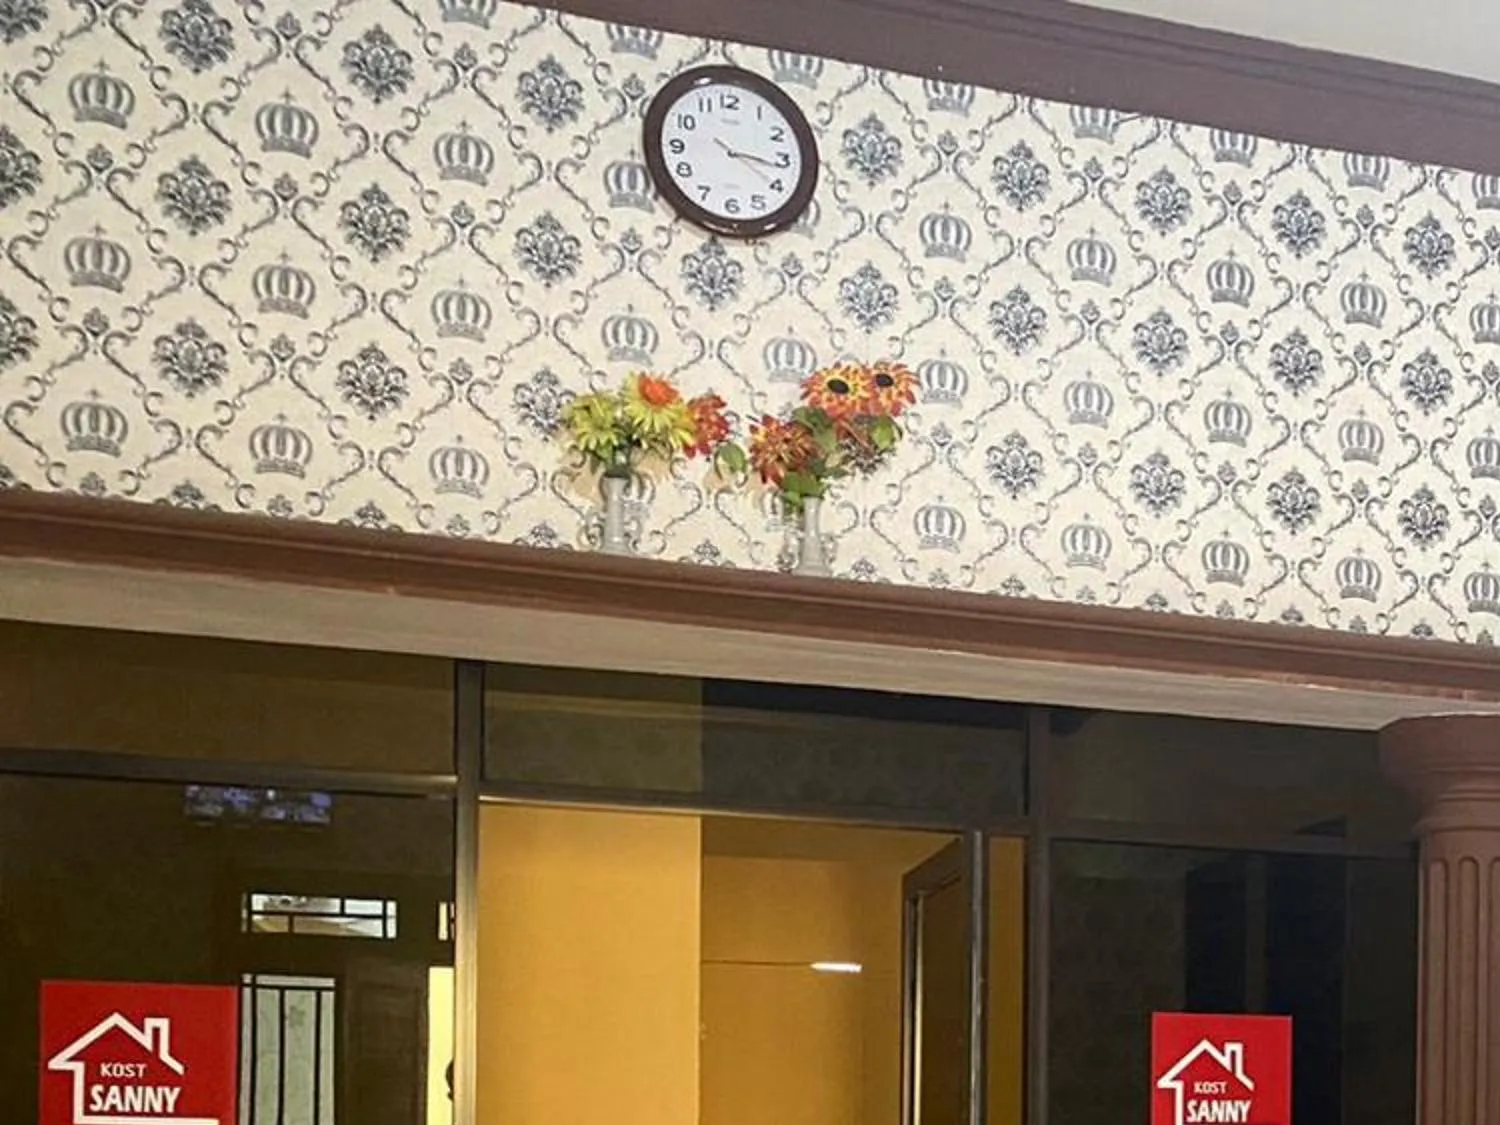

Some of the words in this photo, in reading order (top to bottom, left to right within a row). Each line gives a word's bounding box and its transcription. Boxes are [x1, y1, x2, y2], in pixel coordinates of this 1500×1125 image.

[699, 98, 713, 113] 11
[720, 93, 740, 111] 12
[677, 114, 696, 131] 10
[770, 126, 785, 143] 2
[669, 138, 685, 154] 9
[775, 152, 791, 169] 3
[676, 161, 693, 178] 8
[698, 185, 712, 201] 7
[769, 178, 784, 193] 4
[725, 199, 741, 214] 6
[751, 195, 767, 211] 5
[100, 1062, 147, 1078] KOST
[1194, 1081, 1228, 1094] KOST
[90, 1084, 181, 1113] SANNY
[1186, 1099, 1252, 1124] SANNY
